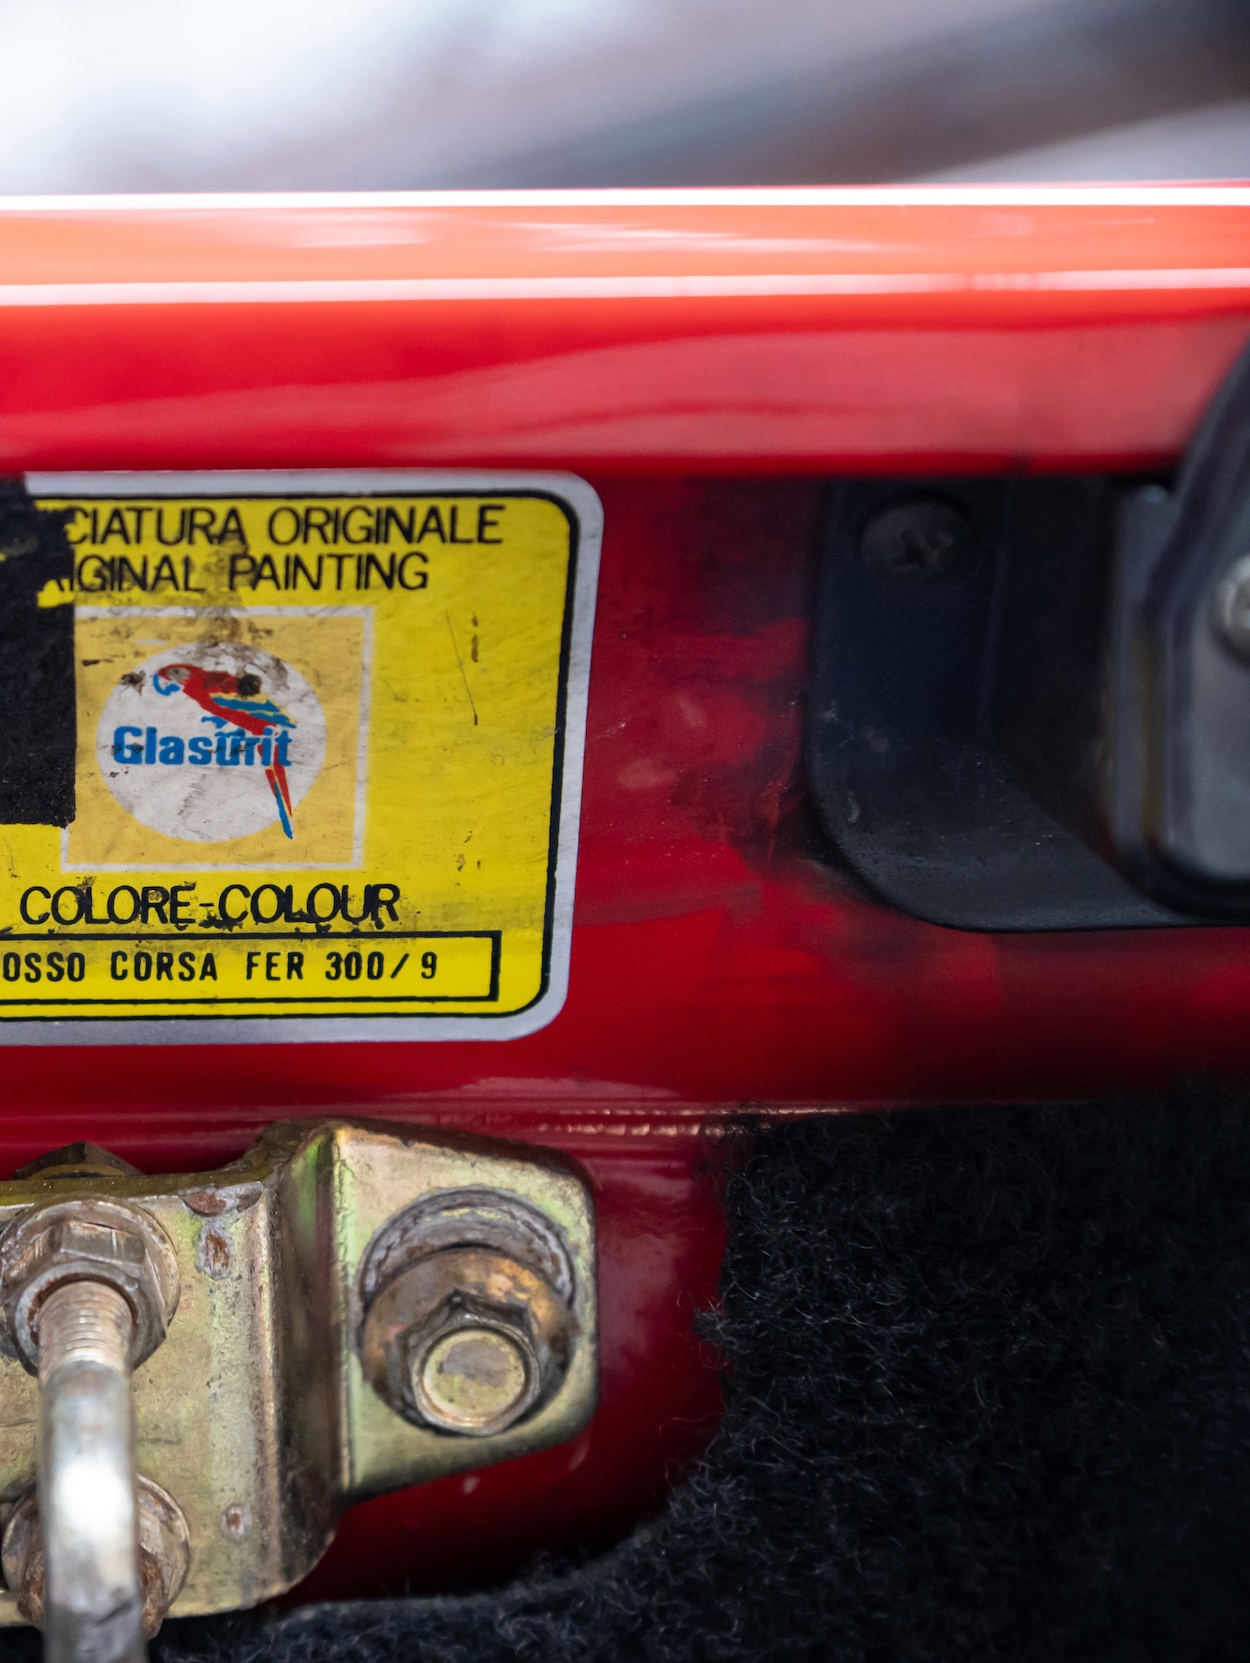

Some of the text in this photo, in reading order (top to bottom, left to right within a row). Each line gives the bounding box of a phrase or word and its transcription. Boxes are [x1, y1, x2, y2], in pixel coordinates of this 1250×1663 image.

[267, 503, 506, 545] ORIGINALE
[228, 551, 430, 591] PAINTING
[113, 725, 293, 767] Glasurit
[19, 882, 402, 926] COLORE-COLOUR
[110, 951, 219, 983] CORSA
[245, 949, 305, 982] FER
[325, 949, 439, 982] 300/9
